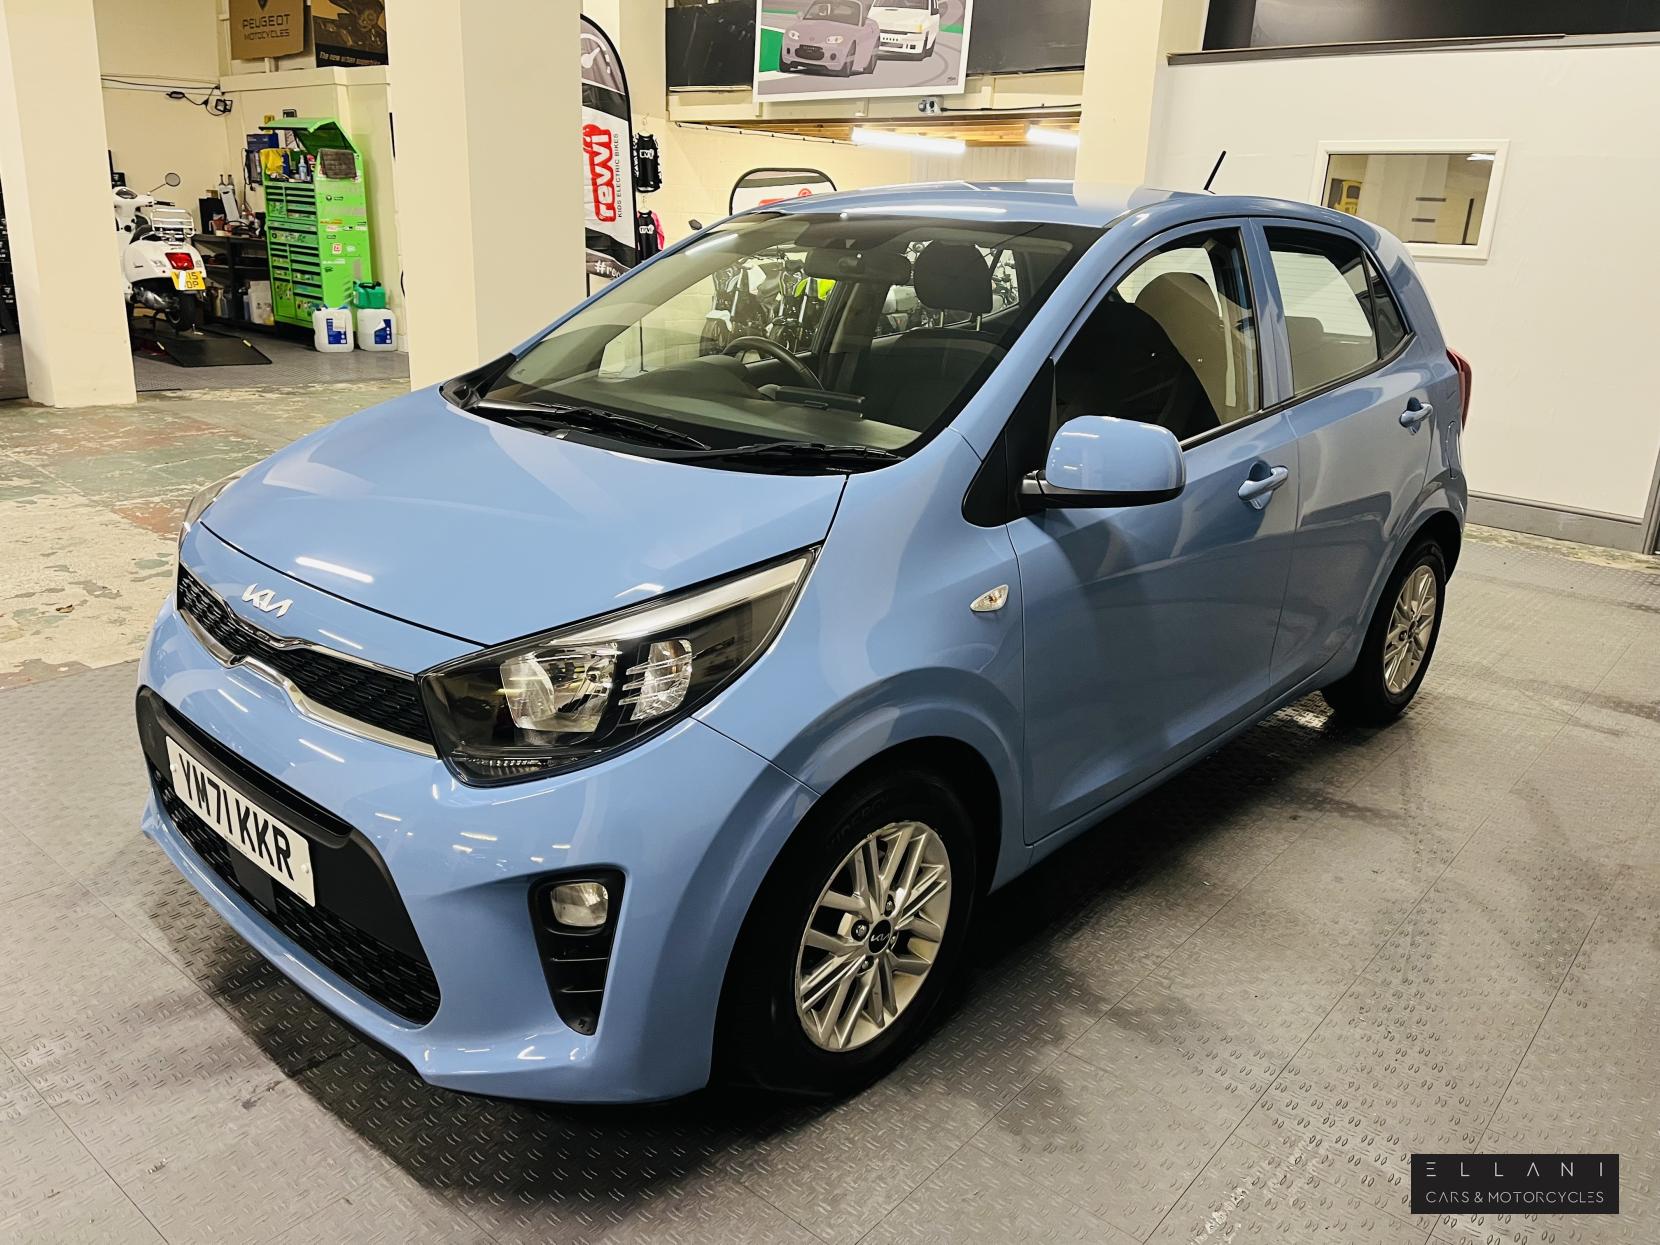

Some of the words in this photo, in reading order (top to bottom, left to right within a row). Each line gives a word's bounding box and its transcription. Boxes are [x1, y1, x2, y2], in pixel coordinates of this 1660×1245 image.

[242, 14, 290, 30] PEUGEOT
[583, 129, 615, 219] revvi
[614, 160, 622, 199] ELECTRIC
[241, 582, 294, 619] KIA
[178, 752, 233, 836] YM71
[235, 797, 295, 882] KKR
